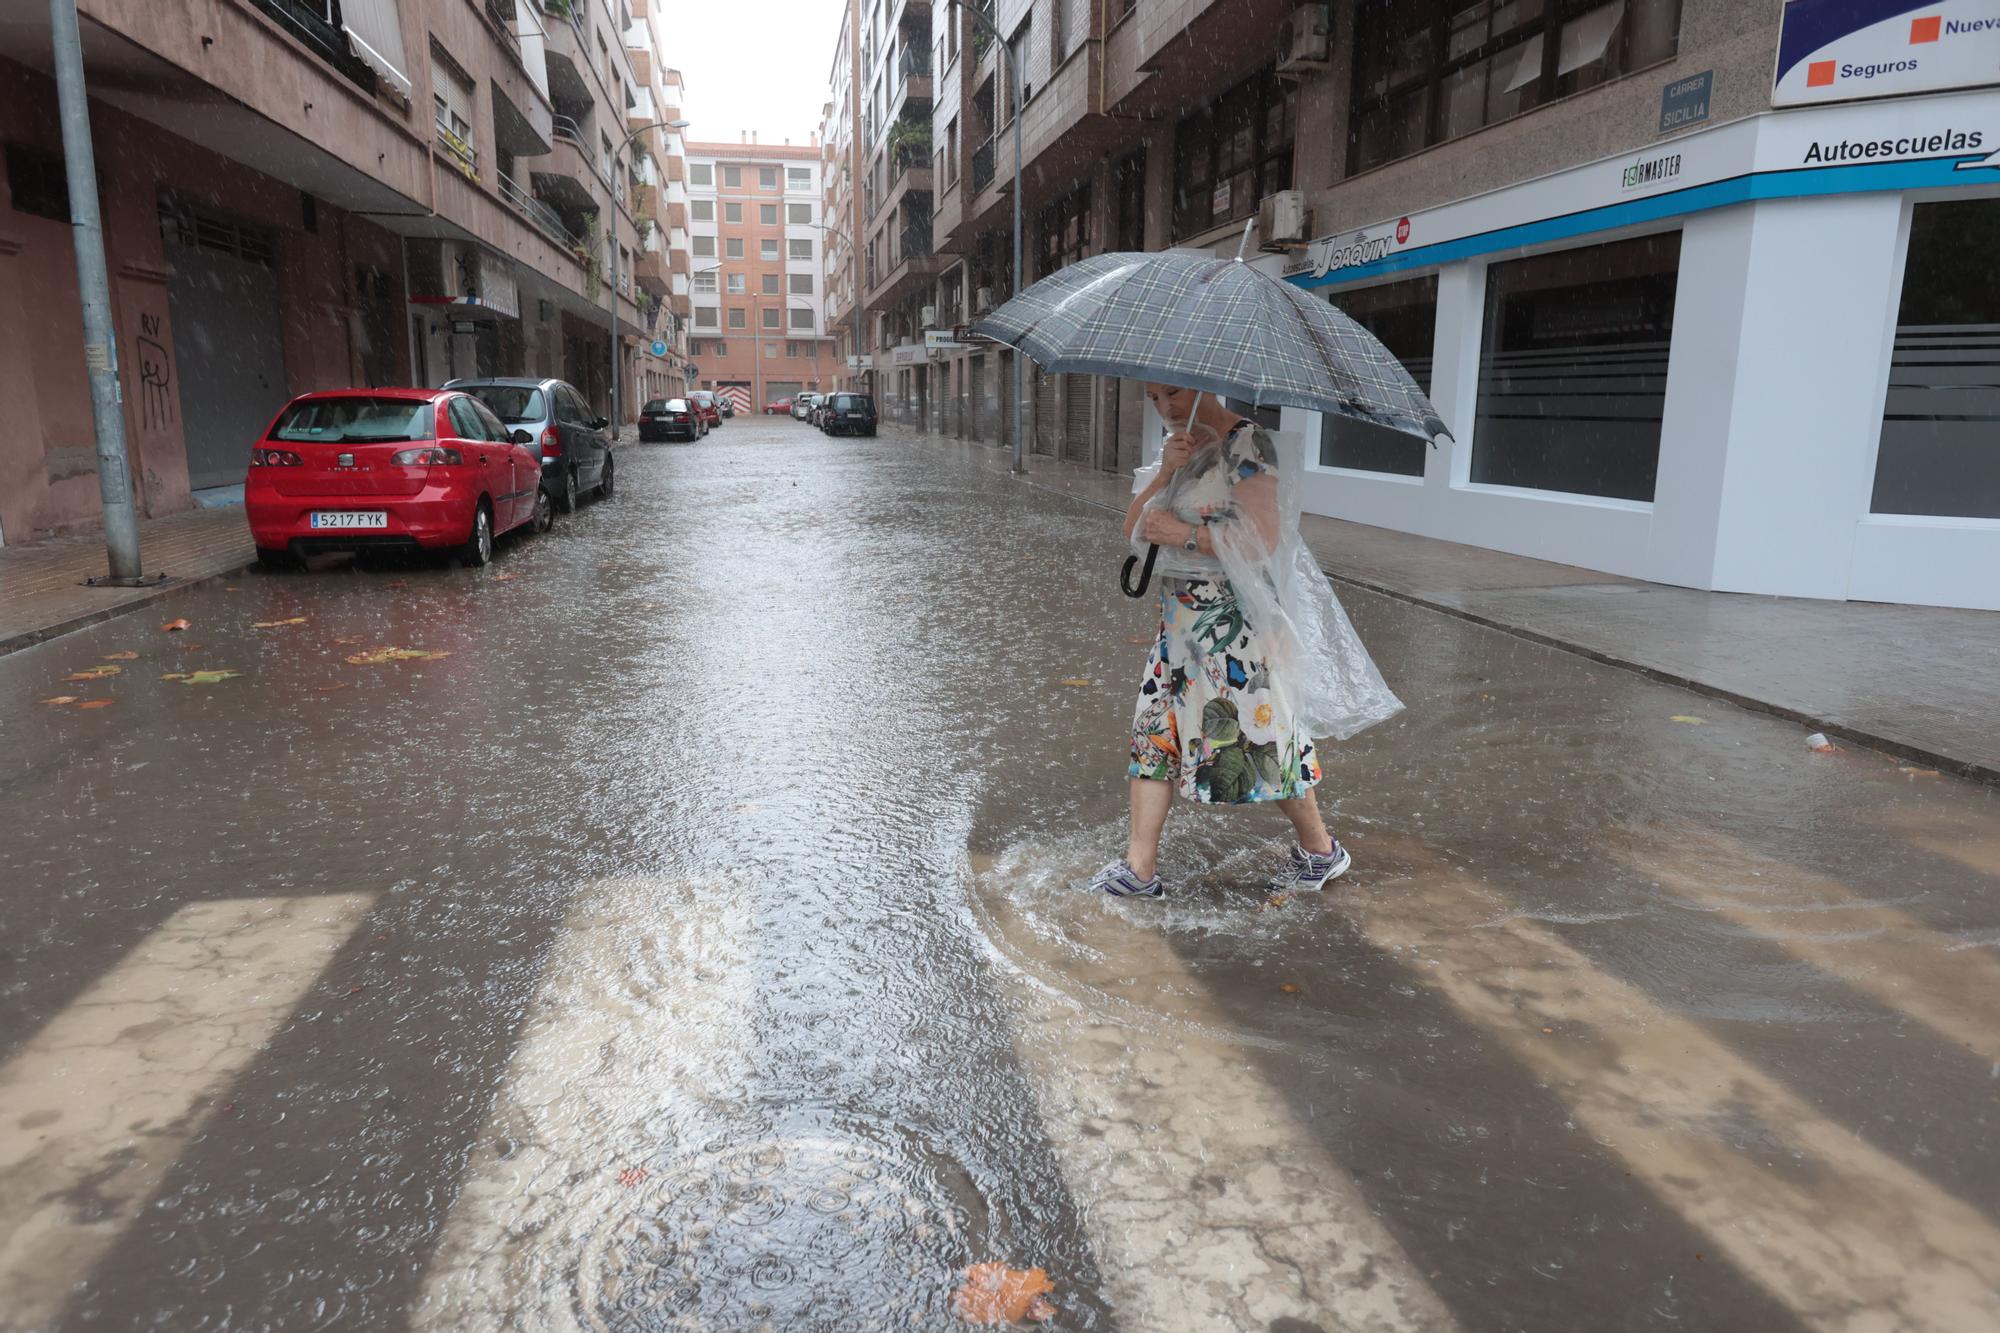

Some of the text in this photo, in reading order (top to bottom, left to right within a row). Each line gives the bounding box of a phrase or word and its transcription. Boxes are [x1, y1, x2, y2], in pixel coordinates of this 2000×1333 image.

[1840, 59, 1918, 80] Seguros
[1670, 77, 1705, 98] CARRER
[1803, 129, 1983, 163] Autoescuelas
[1309, 236, 1393, 278] JOAQUIN
[321, 514, 383, 526] 5217 FYK
